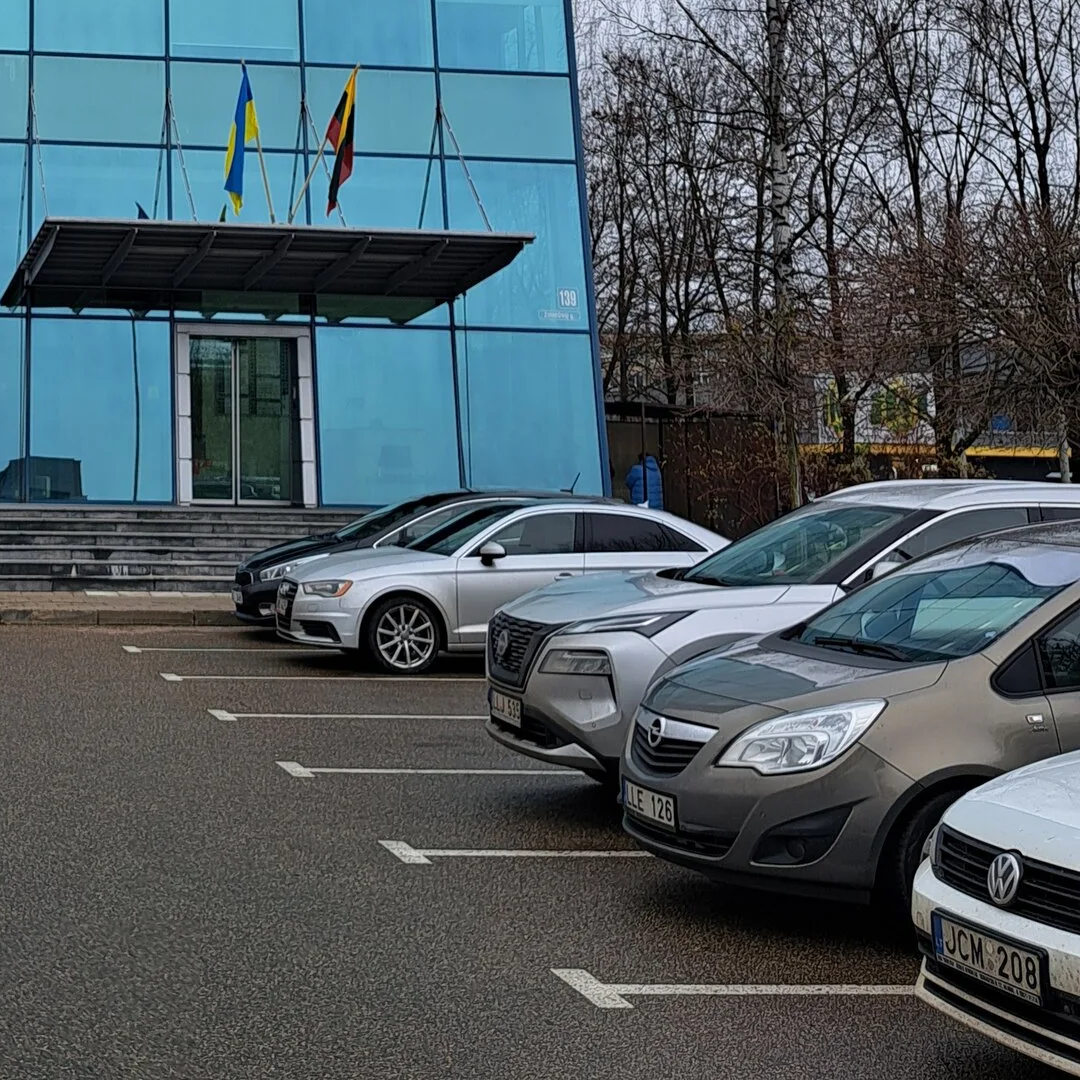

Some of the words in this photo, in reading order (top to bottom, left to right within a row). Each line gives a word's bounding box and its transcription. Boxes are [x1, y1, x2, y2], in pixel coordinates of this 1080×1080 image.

[651, 795, 672, 822] 126
[945, 926, 984, 969] JCM
[997, 946, 1038, 990] 208
